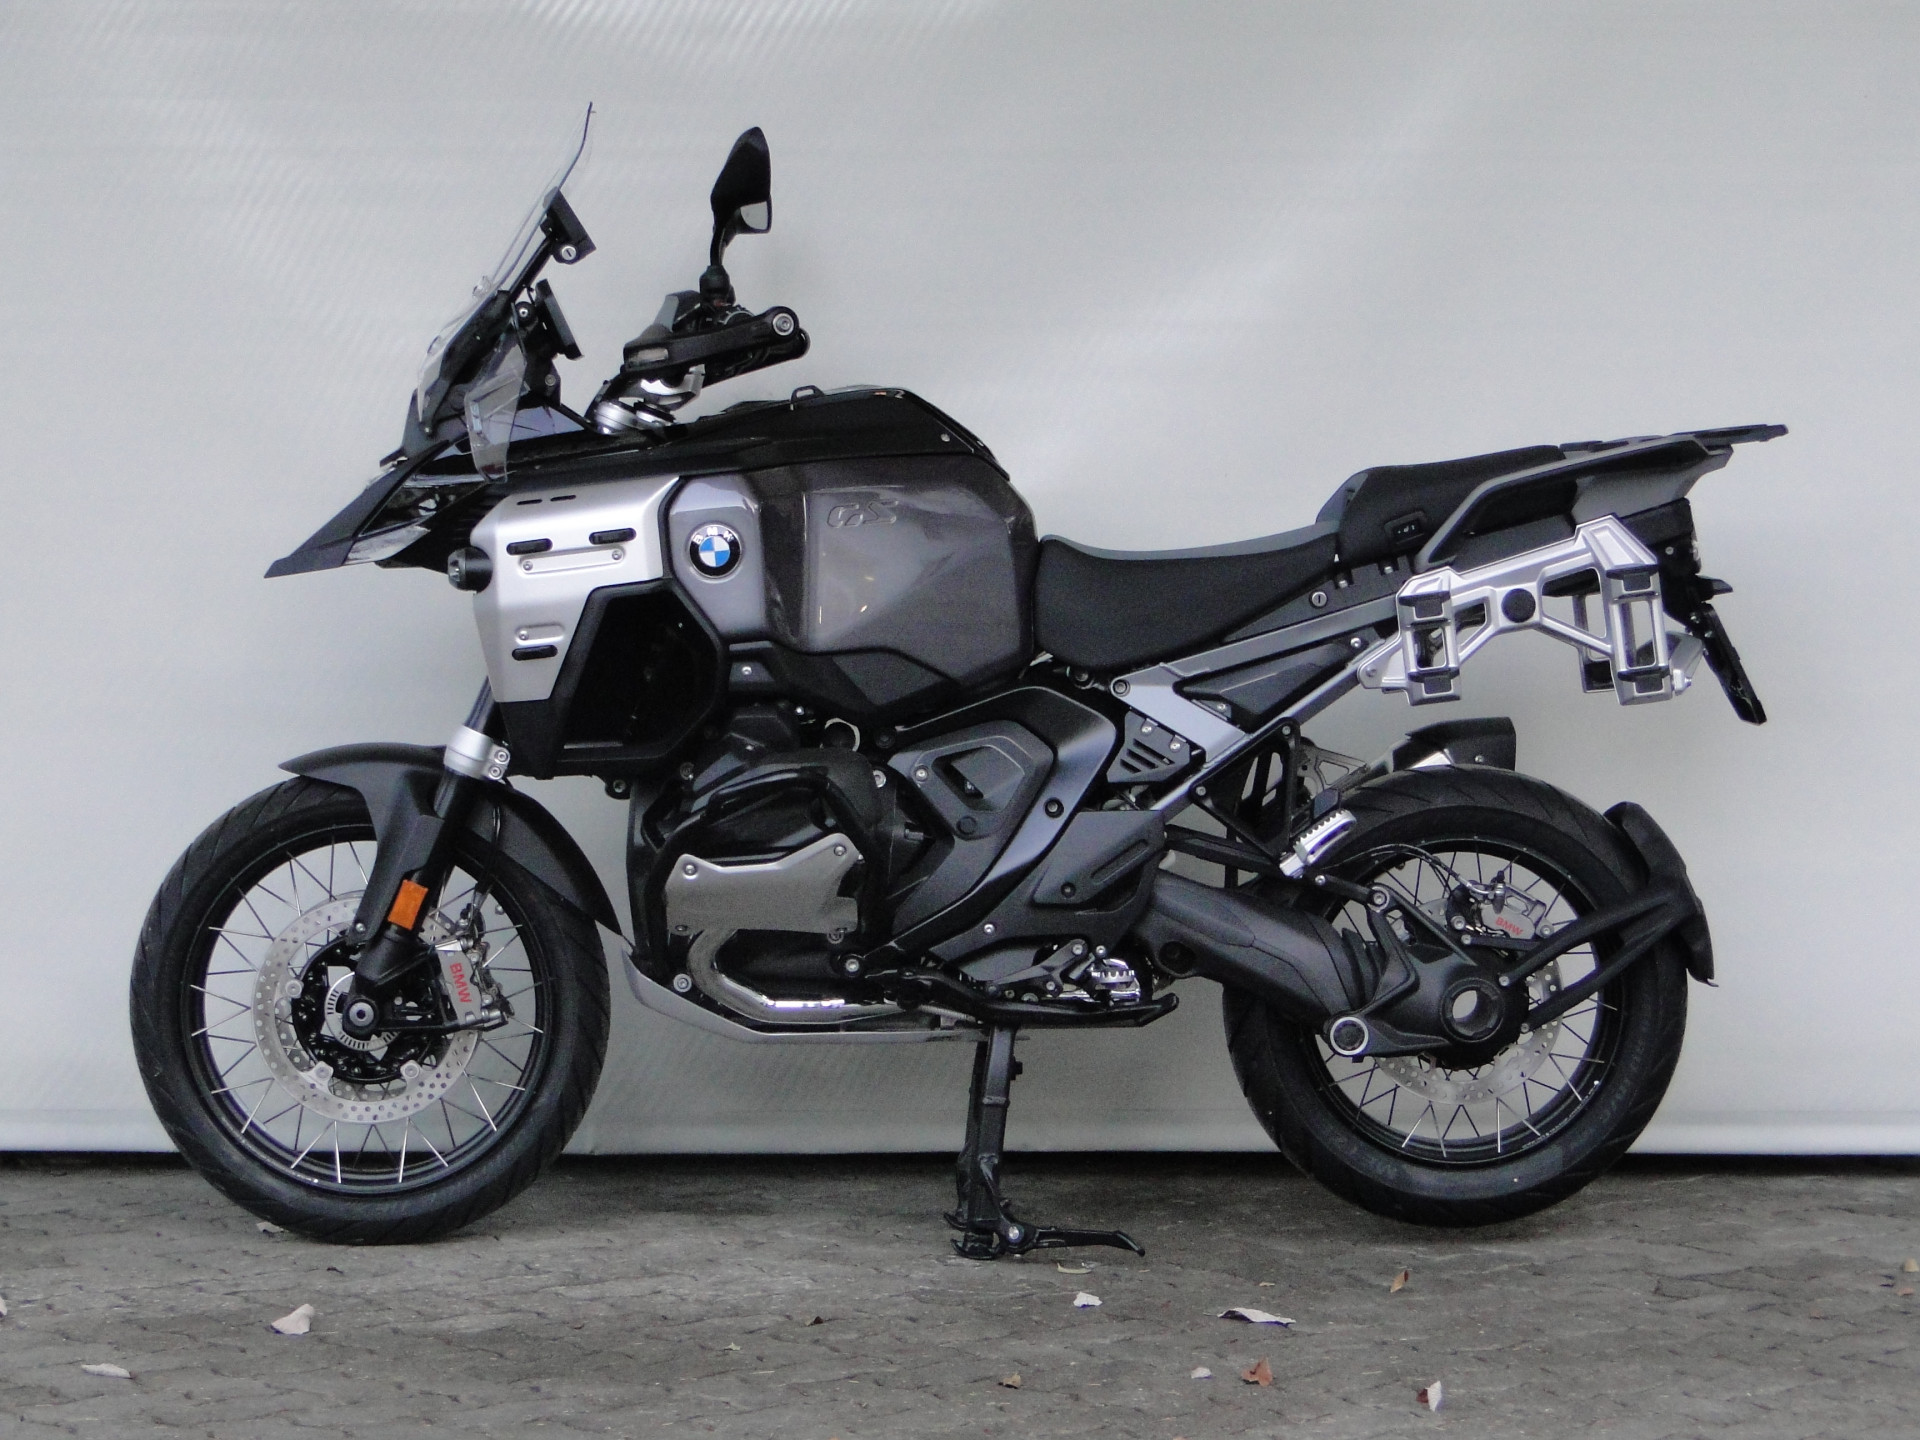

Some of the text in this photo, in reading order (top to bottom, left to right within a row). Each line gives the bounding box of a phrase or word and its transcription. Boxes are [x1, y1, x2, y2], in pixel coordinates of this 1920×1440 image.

[827, 500, 899, 527] GS
[693, 527, 734, 544] BMW
[1496, 917, 1523, 935] BMW
[451, 963, 472, 1002] BMW
